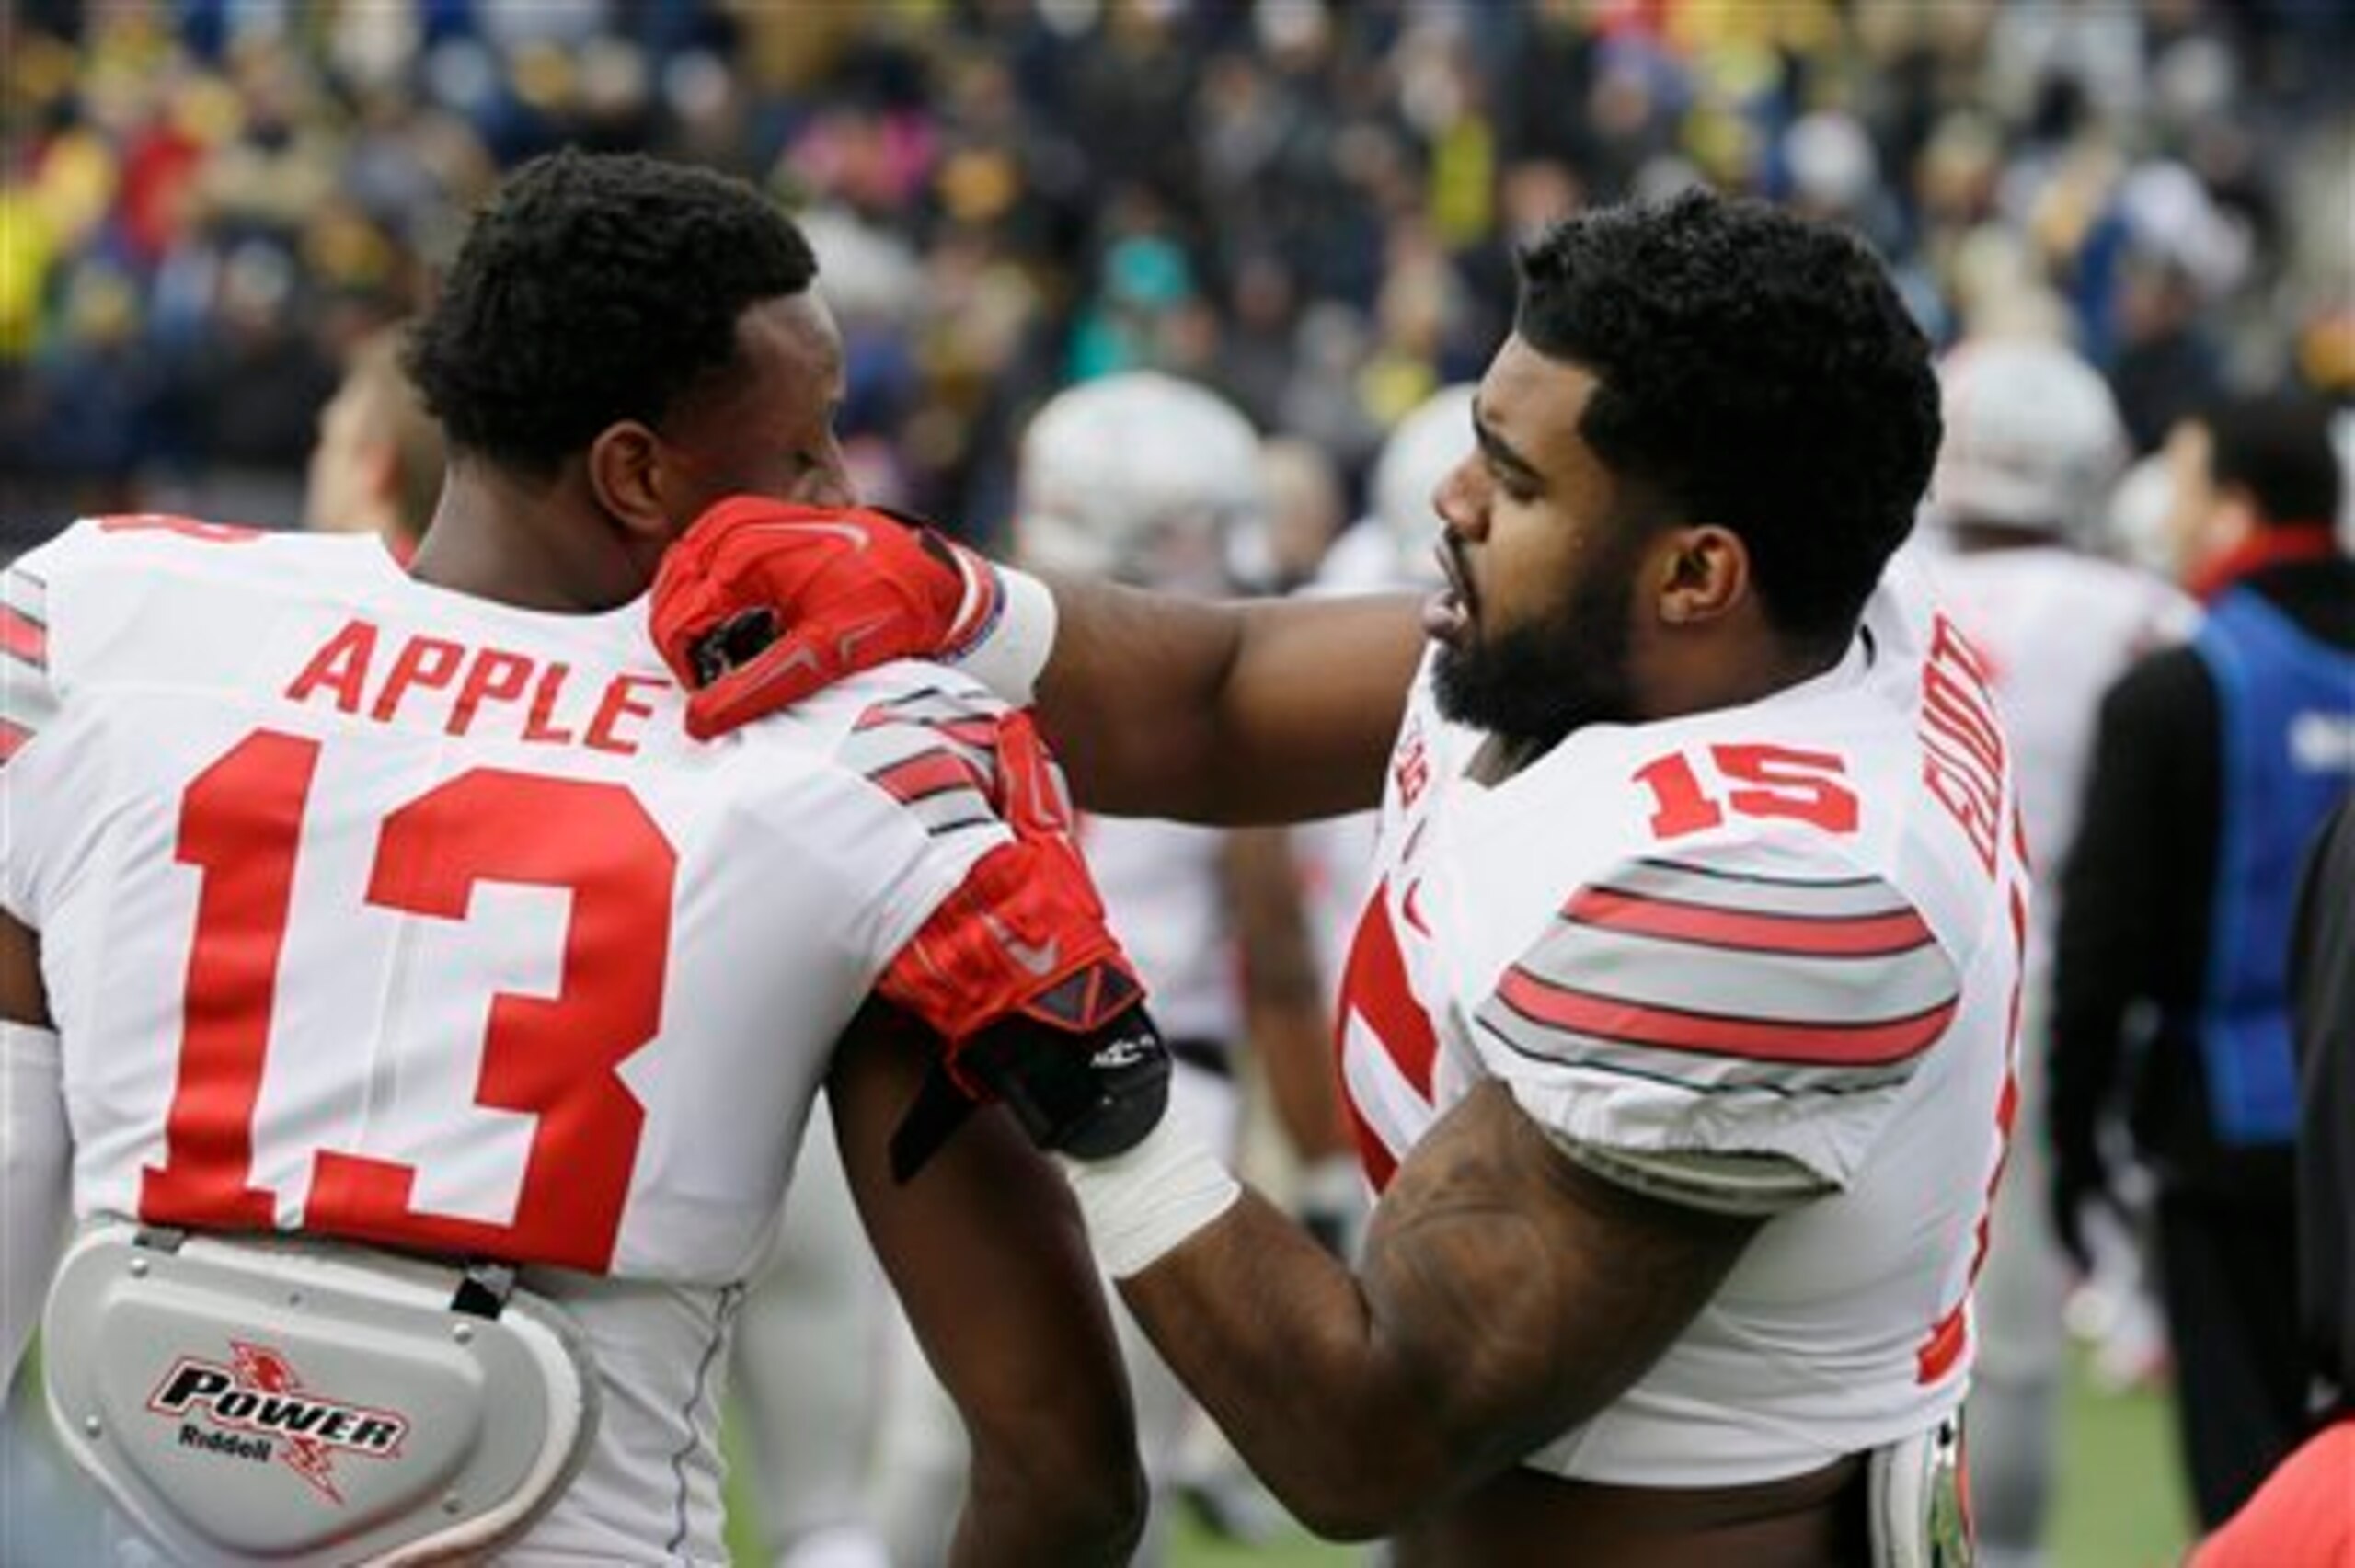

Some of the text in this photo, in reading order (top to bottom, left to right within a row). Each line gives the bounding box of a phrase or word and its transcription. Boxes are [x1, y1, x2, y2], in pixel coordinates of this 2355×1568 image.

[284, 619, 672, 756] APPLE
[1630, 743, 1859, 839] 15
[138, 727, 679, 1276] 13
[158, 1367, 398, 1448] POWER
[179, 1424, 273, 1462] Riddell
